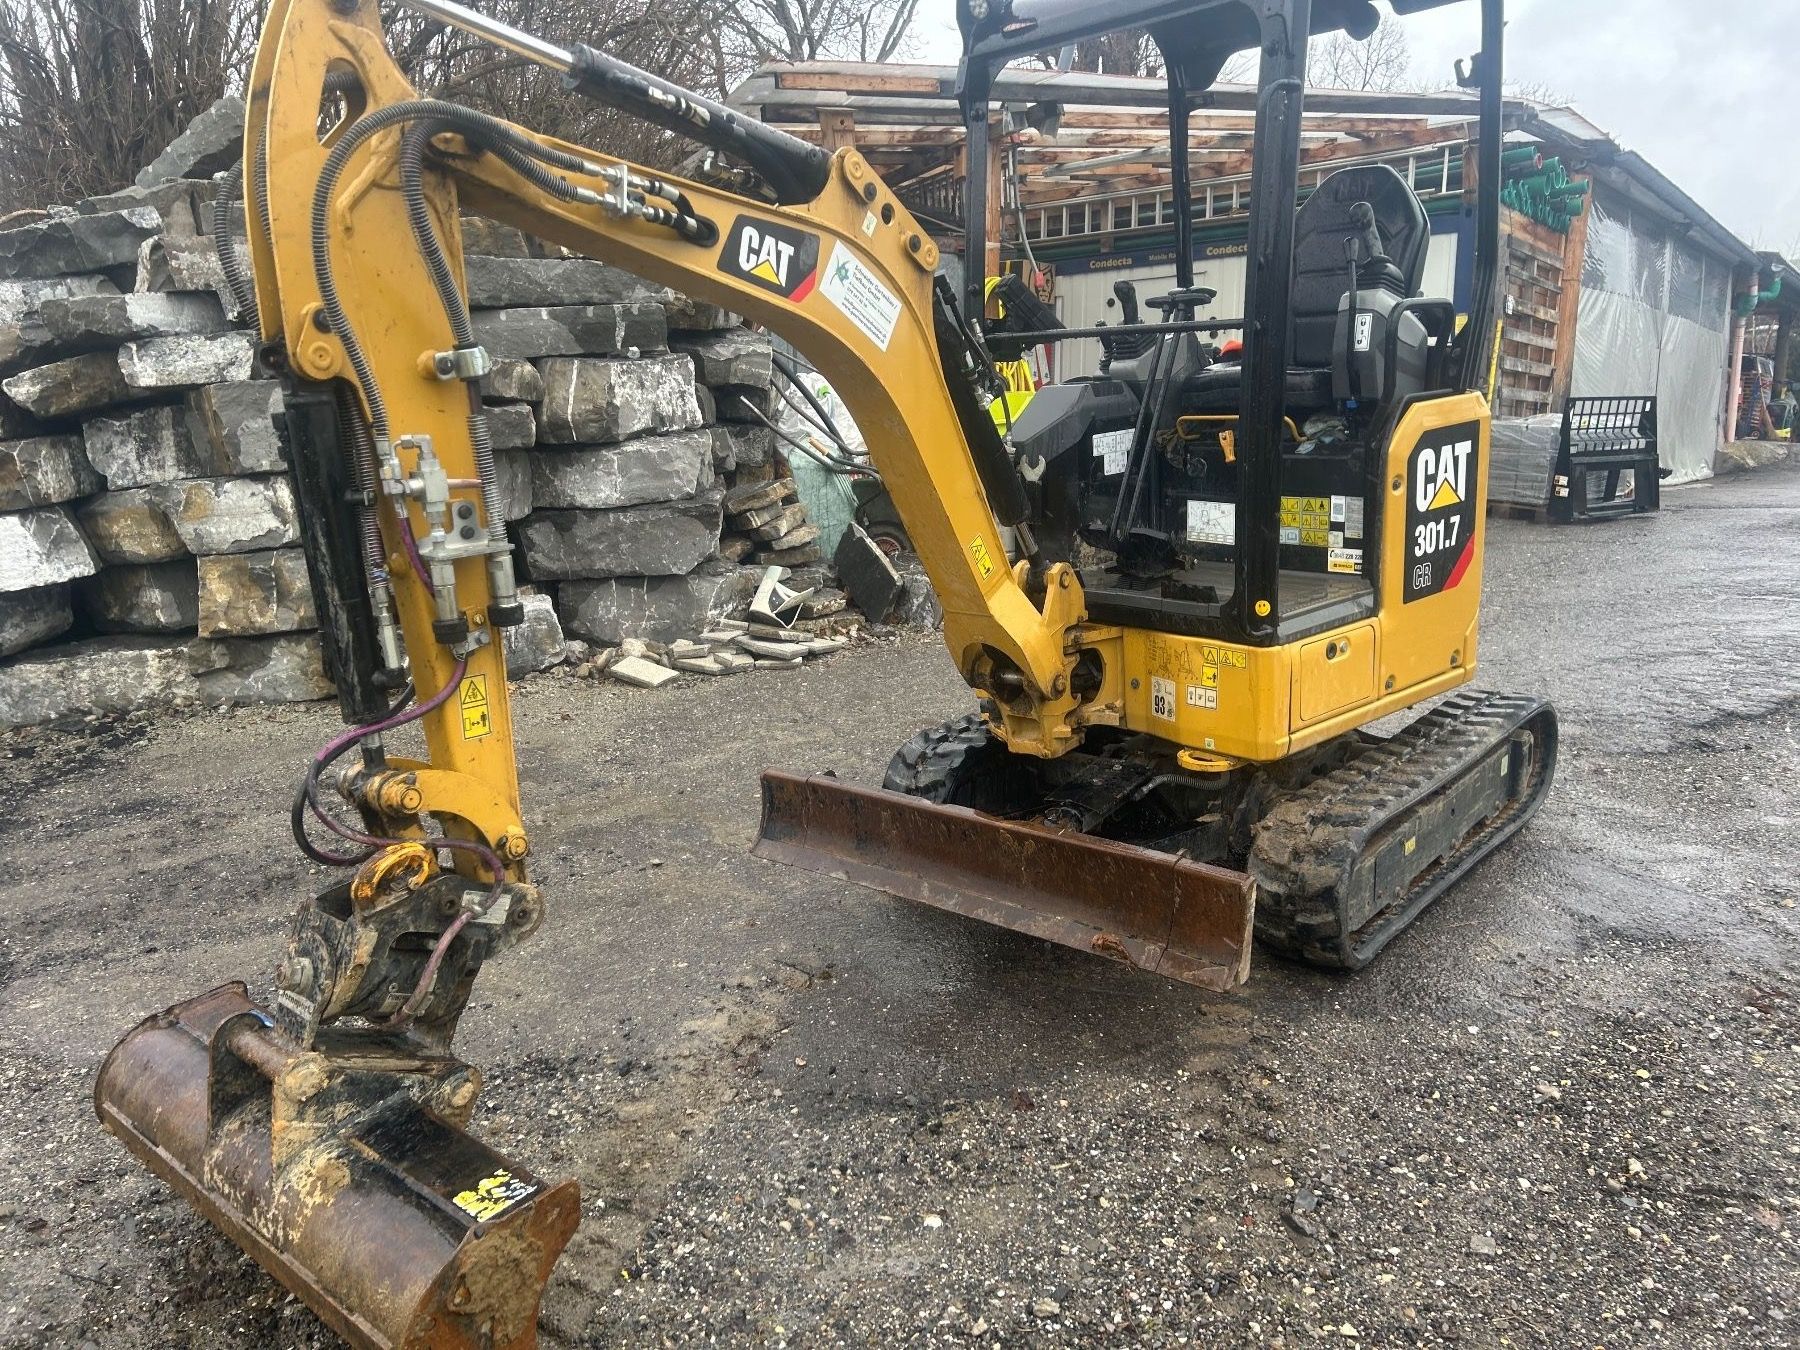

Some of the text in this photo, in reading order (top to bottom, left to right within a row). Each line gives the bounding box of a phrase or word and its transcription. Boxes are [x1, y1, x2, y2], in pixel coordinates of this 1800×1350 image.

[739, 226, 794, 287] CAT
[1090, 257, 1132, 269] Condecta
[1206, 243, 1247, 256] Condect
[1416, 440, 1471, 513] CAT
[1415, 515, 1461, 558] 301.7
[1413, 562, 1432, 590] CR
[1154, 695, 1165, 715] 93
